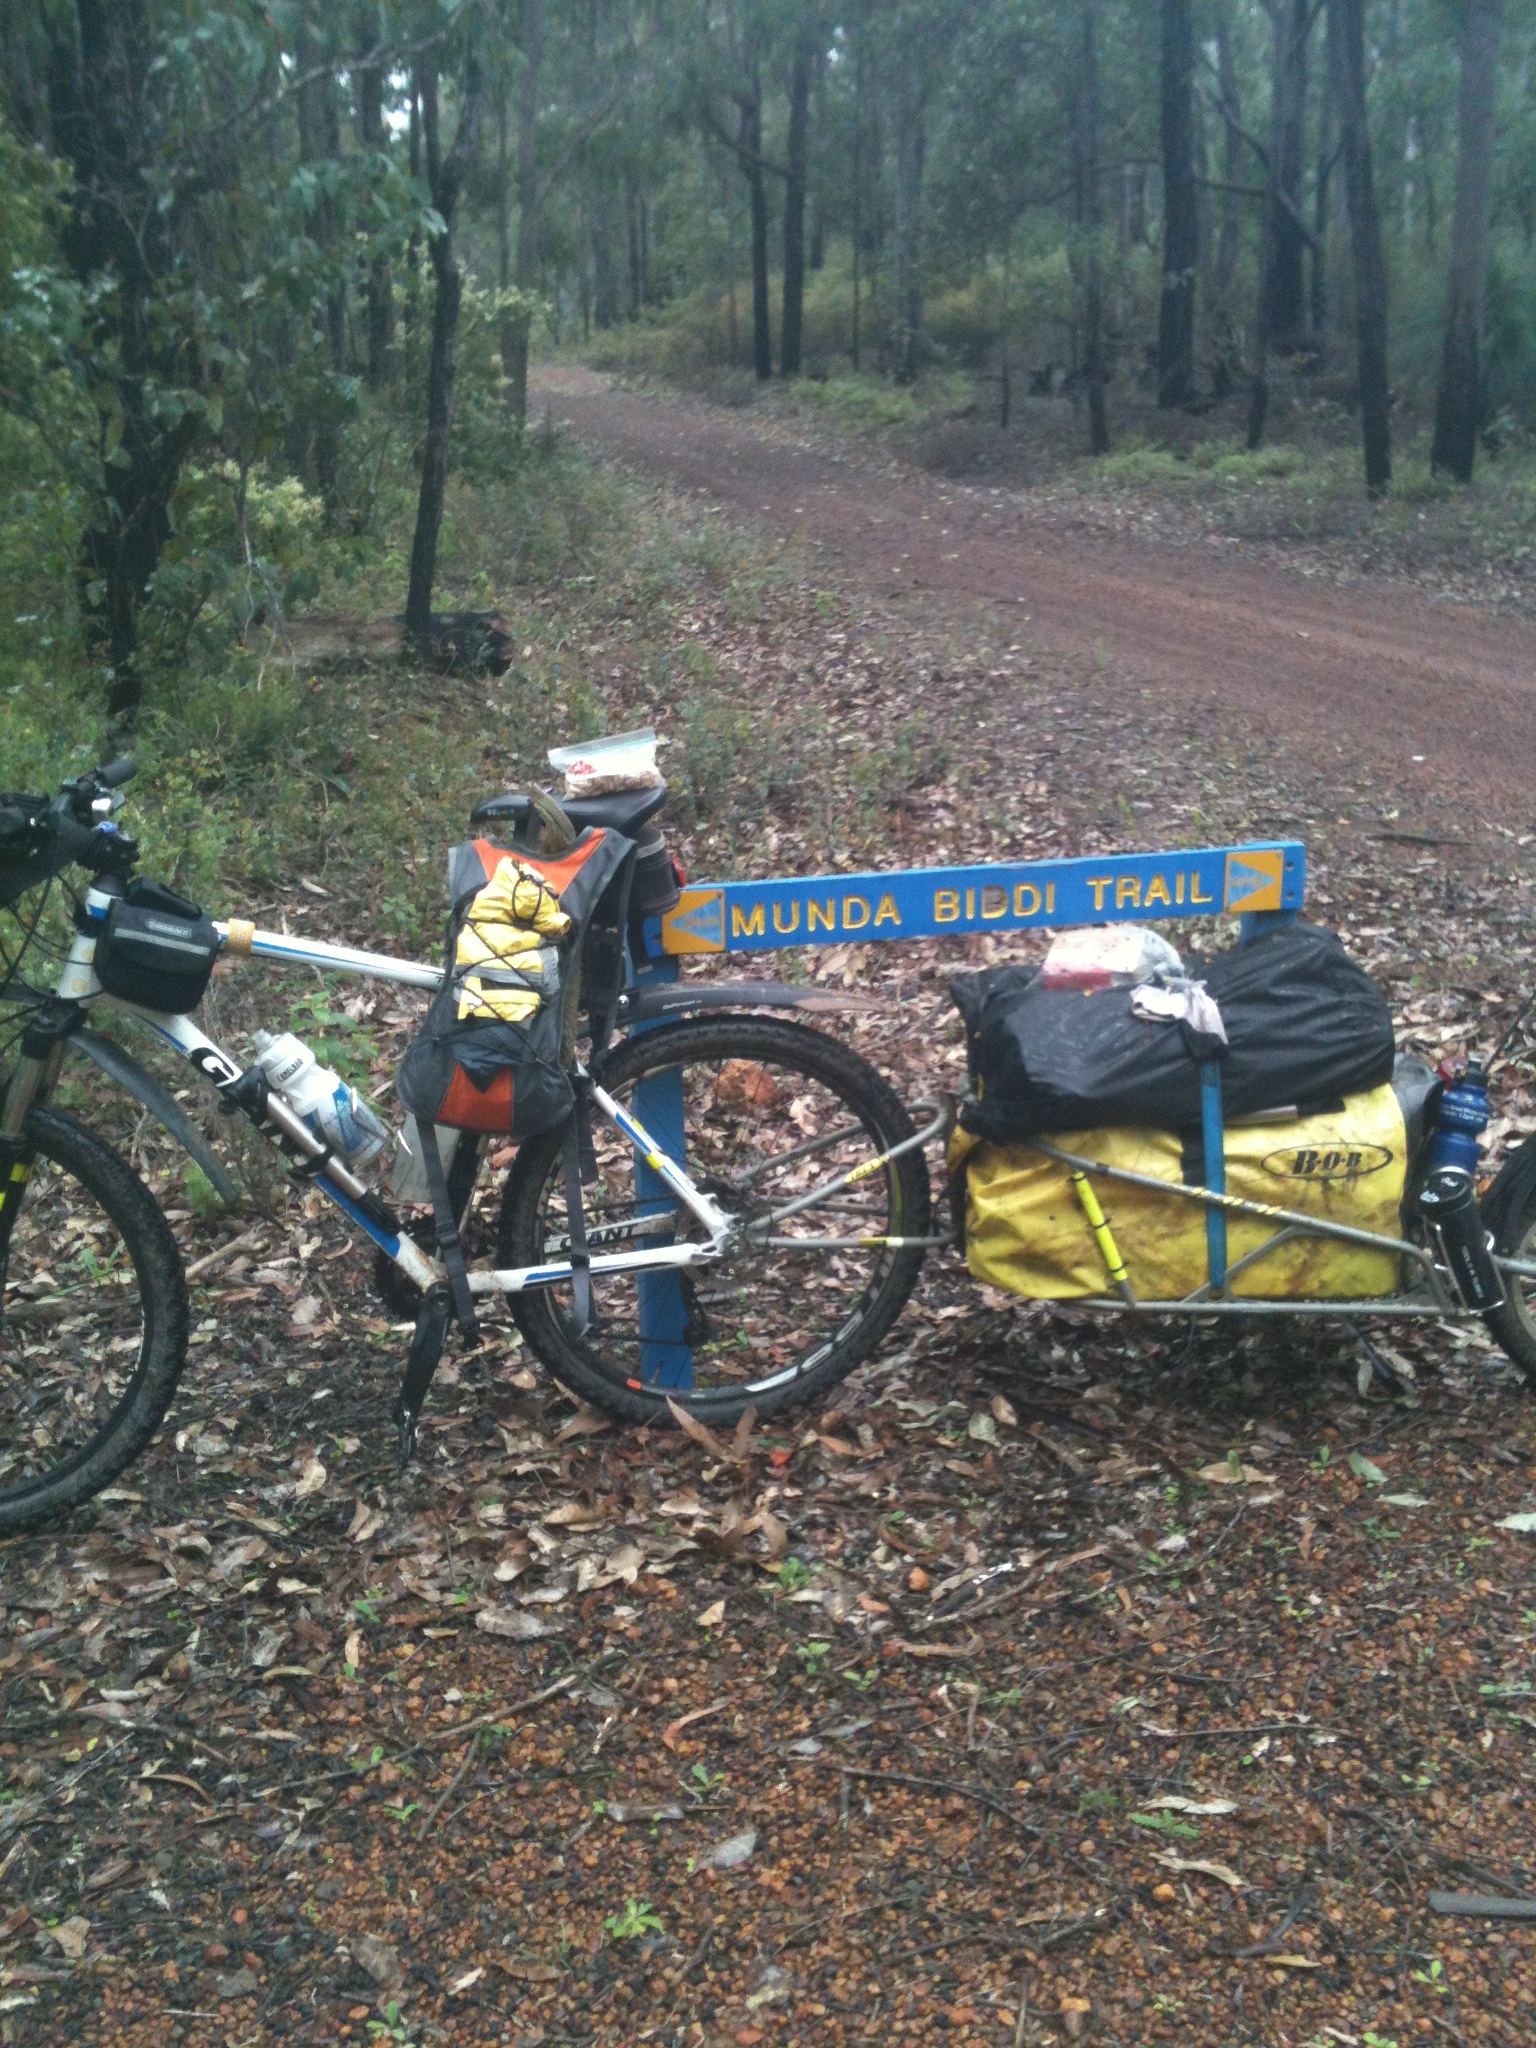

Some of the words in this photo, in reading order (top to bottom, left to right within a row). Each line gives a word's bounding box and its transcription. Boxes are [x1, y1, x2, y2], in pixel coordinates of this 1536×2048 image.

[731, 892, 902, 938] MUNDA
[934, 880, 1055, 923] BIDDI
[1085, 870, 1213, 911] TRAIL
